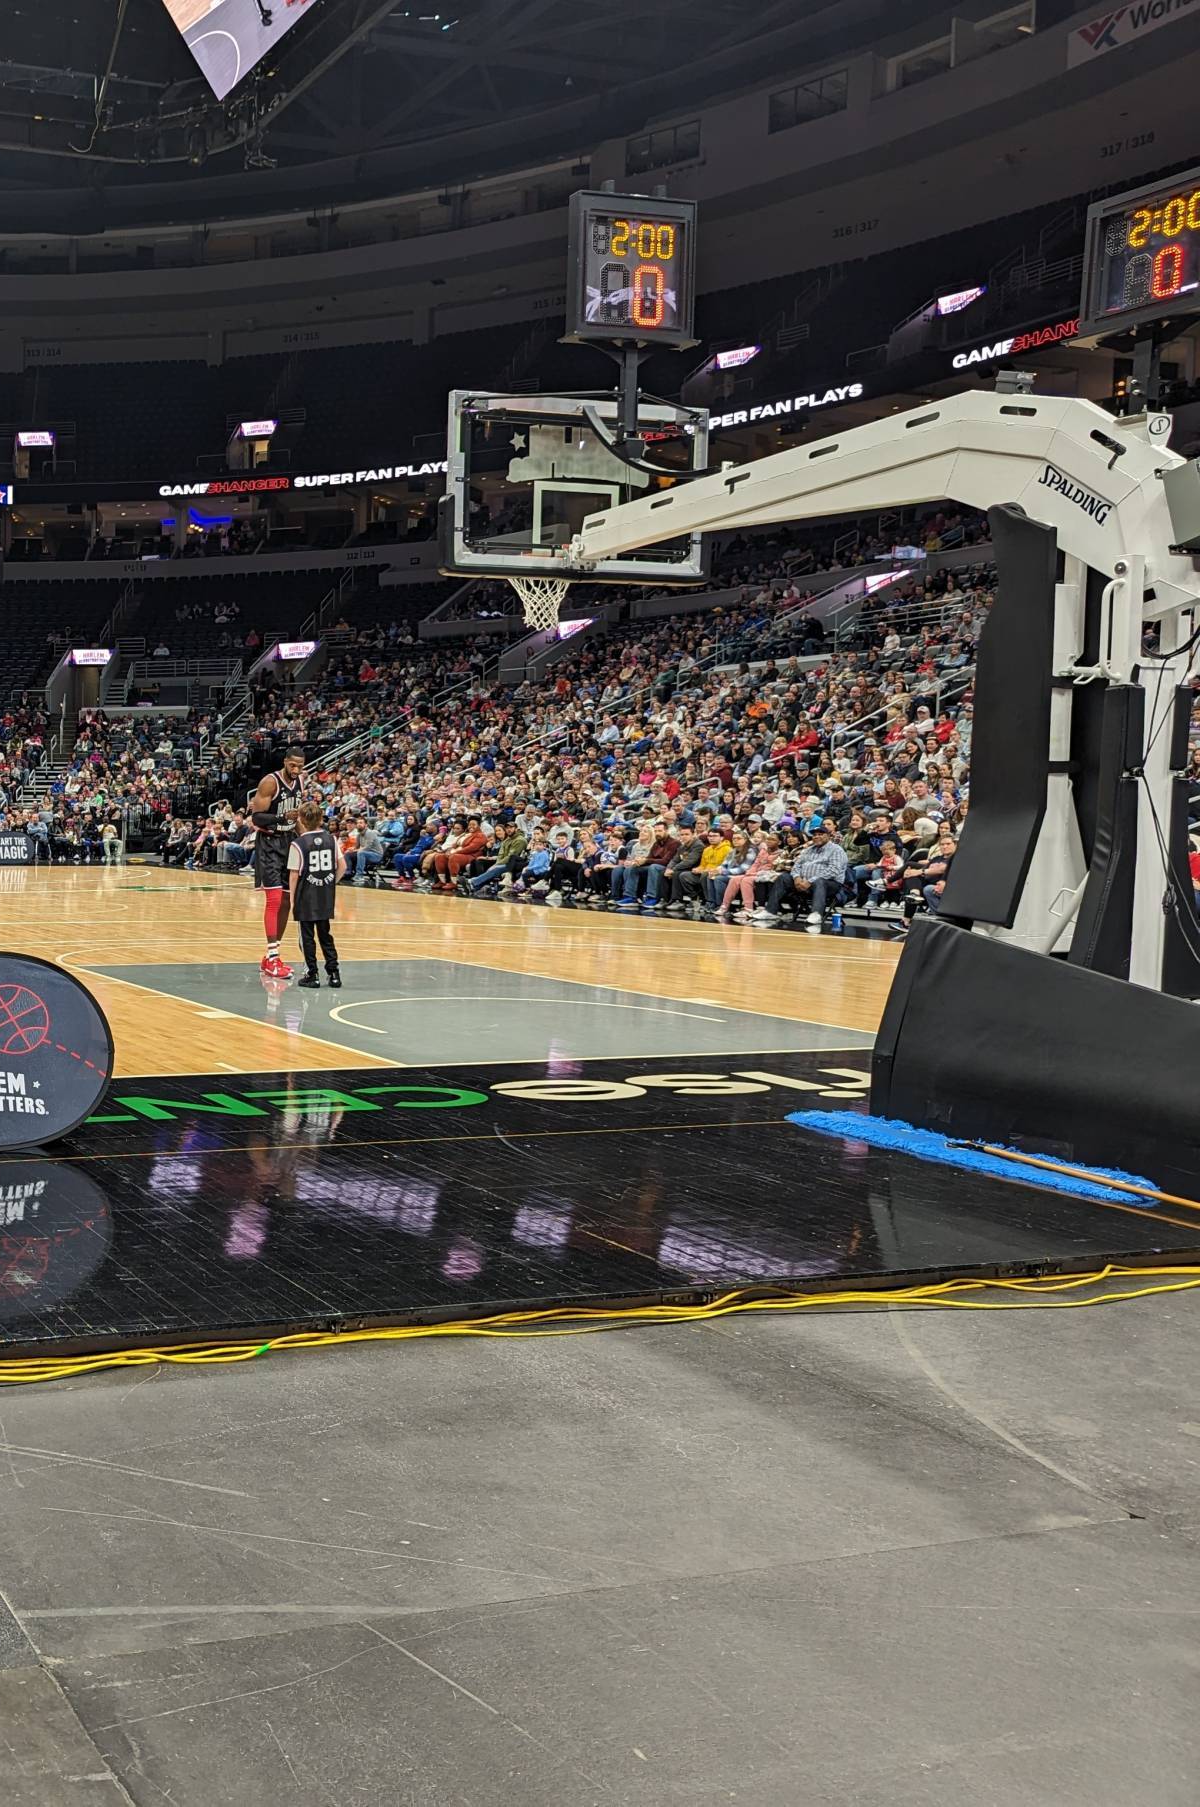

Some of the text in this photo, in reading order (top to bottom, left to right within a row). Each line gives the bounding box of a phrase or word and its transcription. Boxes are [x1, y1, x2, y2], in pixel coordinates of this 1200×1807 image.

[611, 220, 675, 260] 2:00
[633, 263, 665, 328] 0
[749, 399, 792, 422] FAN
[794, 382, 864, 412] PLAYS
[292, 468, 355, 489] SUPER
[354, 465, 394, 482] FAN
[394, 460, 449, 479] PLAYS
[1038, 464, 1113, 527] SPALDING
[13, 836, 27, 846] THE
[308, 849, 333, 873] 98
[305, 873, 324, 888] SUPER
